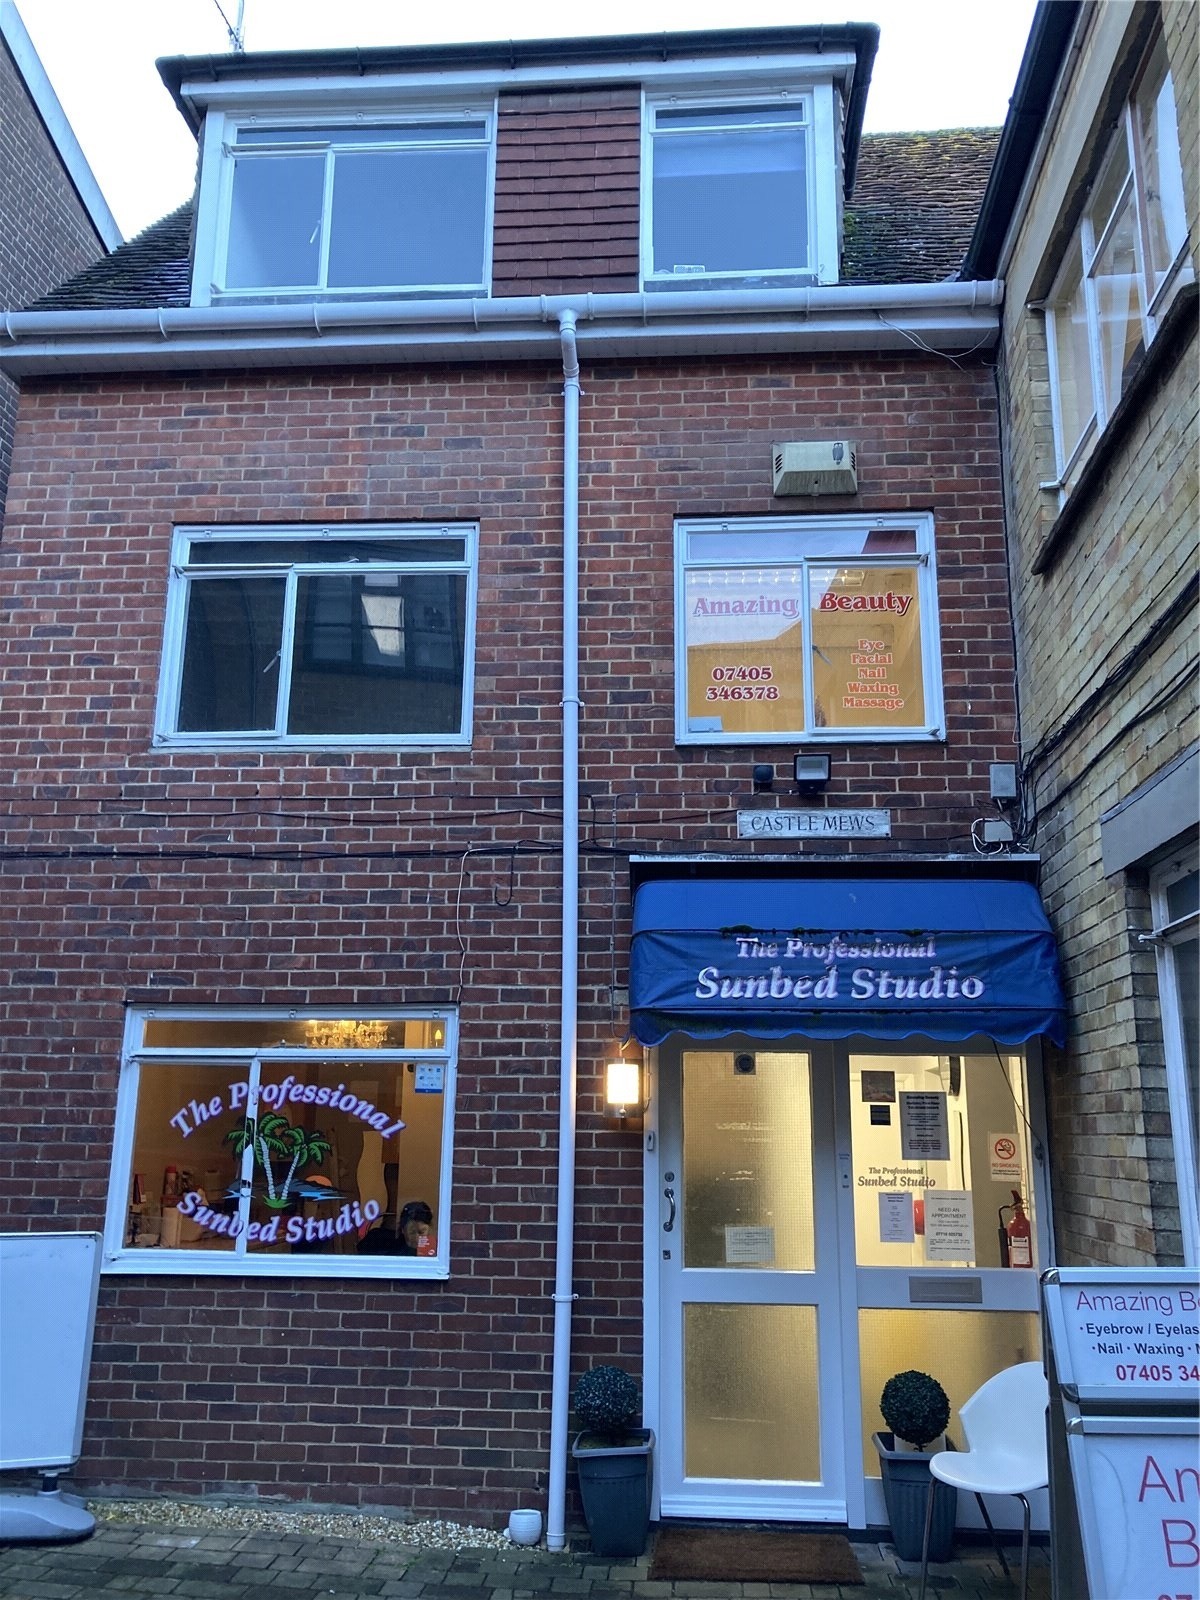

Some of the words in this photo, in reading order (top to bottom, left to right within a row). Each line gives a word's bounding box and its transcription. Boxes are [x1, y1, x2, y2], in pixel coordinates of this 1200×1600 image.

[692, 596, 800, 618] Amazing
[819, 592, 913, 616] Beauty
[858, 639, 884, 652] Eye
[851, 653, 893, 664] Facial
[712, 666, 772, 681] 07405
[857, 668, 887, 679] Nail
[706, 686, 779, 700] 346378
[847, 682, 899, 695] Waxing
[843, 697, 904, 710] Massage
[751, 815, 819, 832] CASTLE
[822, 815, 876, 831] MEWS
[736, 937, 778, 958] The
[783, 935, 937, 964] Professional
[695, 965, 839, 999] Sunbed
[851, 966, 985, 999] Studio
[169, 1096, 223, 1138] The
[228, 1075, 406, 1139] Professional
[868, 1167, 881, 1175] The
[882, 1167, 924, 1176] Professional
[857, 1176, 897, 1187] Sunbed
[900, 1176, 936, 1188] Studio
[176, 1191, 280, 1242] Sunbed
[285, 1199, 380, 1242] Studio
[1076, 1290, 1174, 1316] Amazing
[1179, 1291, 1200, 1311] B
[1086, 1323, 1144, 1337] Eyebrow
[1155, 1323, 1200, 1337] Eyelas
[1097, 1343, 1123, 1354] Nail
[1133, 1343, 1185, 1357] Waxing
[1116, 1365, 1172, 1381] 07405
[1178, 1365, 1200, 1381] 34
